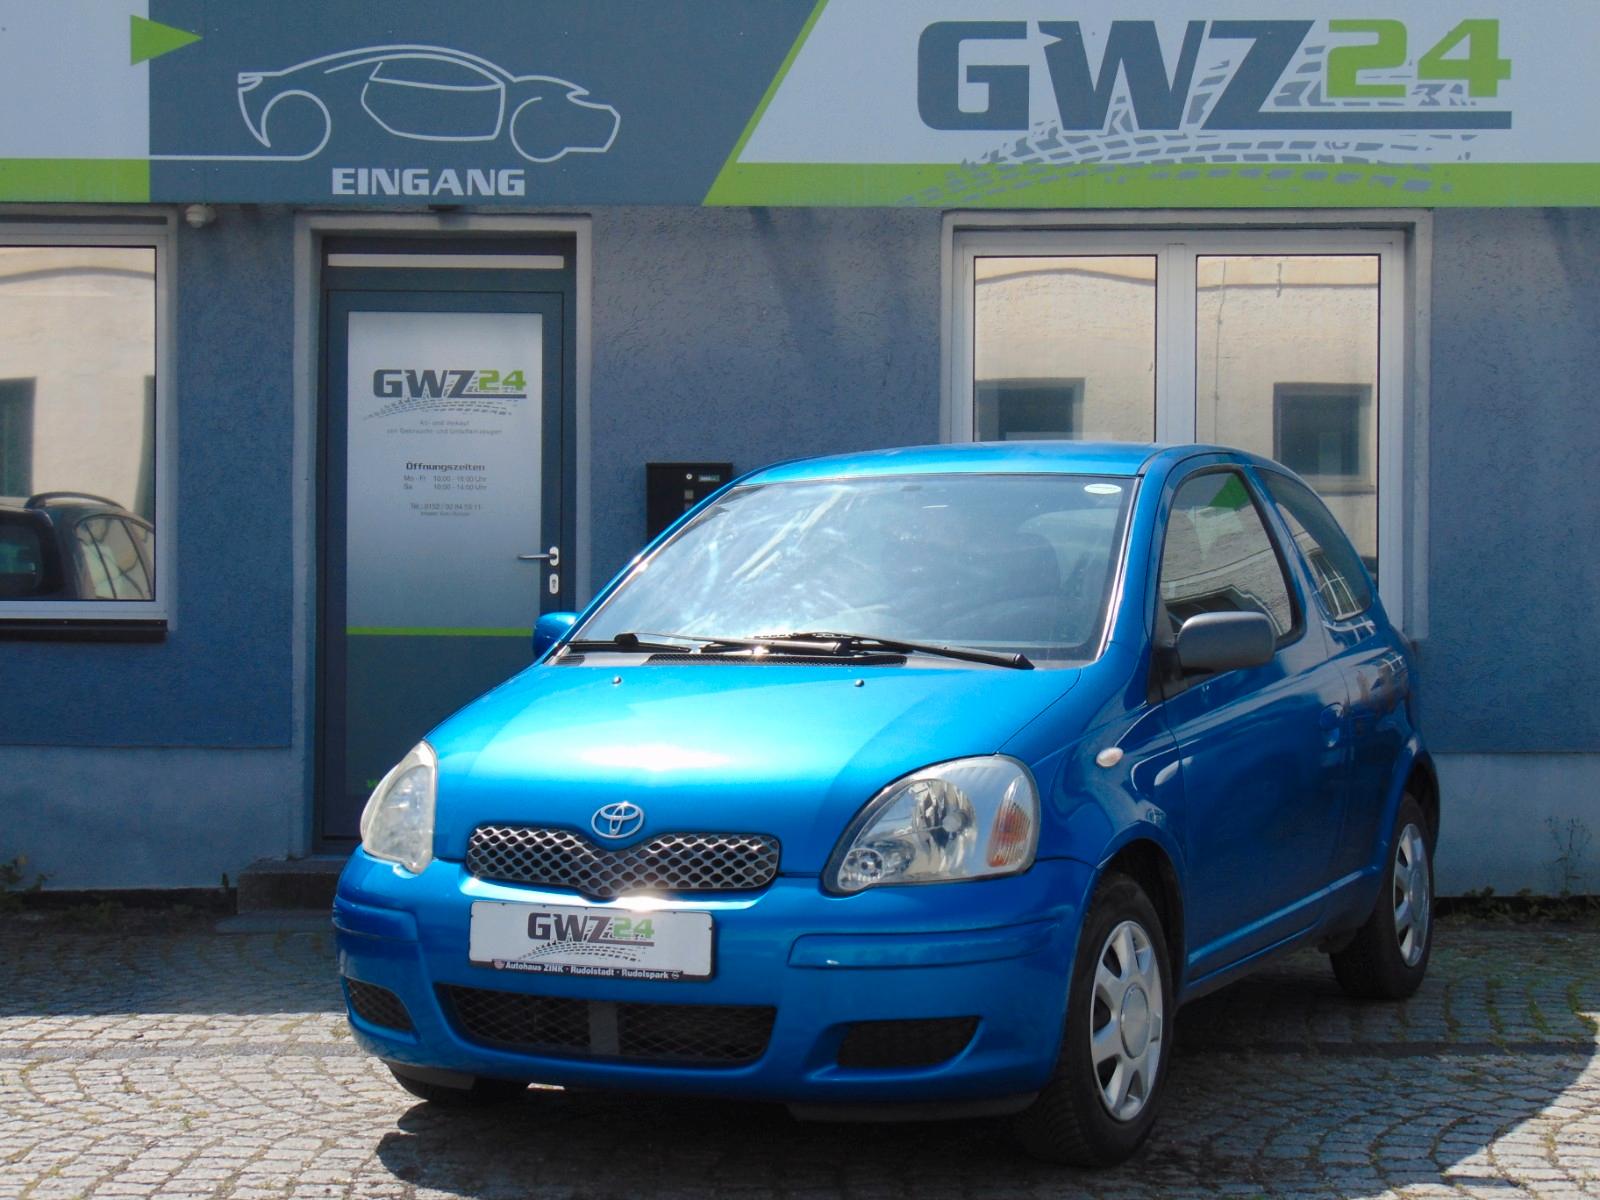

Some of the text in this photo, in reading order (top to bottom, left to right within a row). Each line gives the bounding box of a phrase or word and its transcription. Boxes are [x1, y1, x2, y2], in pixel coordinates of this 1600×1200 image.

[917, 18, 1512, 131] GWZ24
[332, 168, 525, 196] EINGANG
[373, 369, 528, 399] GWZ24
[405, 461, 486, 473] Öffnungszeiten
[527, 912, 655, 947] GWZ24
[505, 961, 542, 971] Autohaus
[543, 963, 564, 973] ZINK
[571, 965, 615, 977] Rudolstadt
